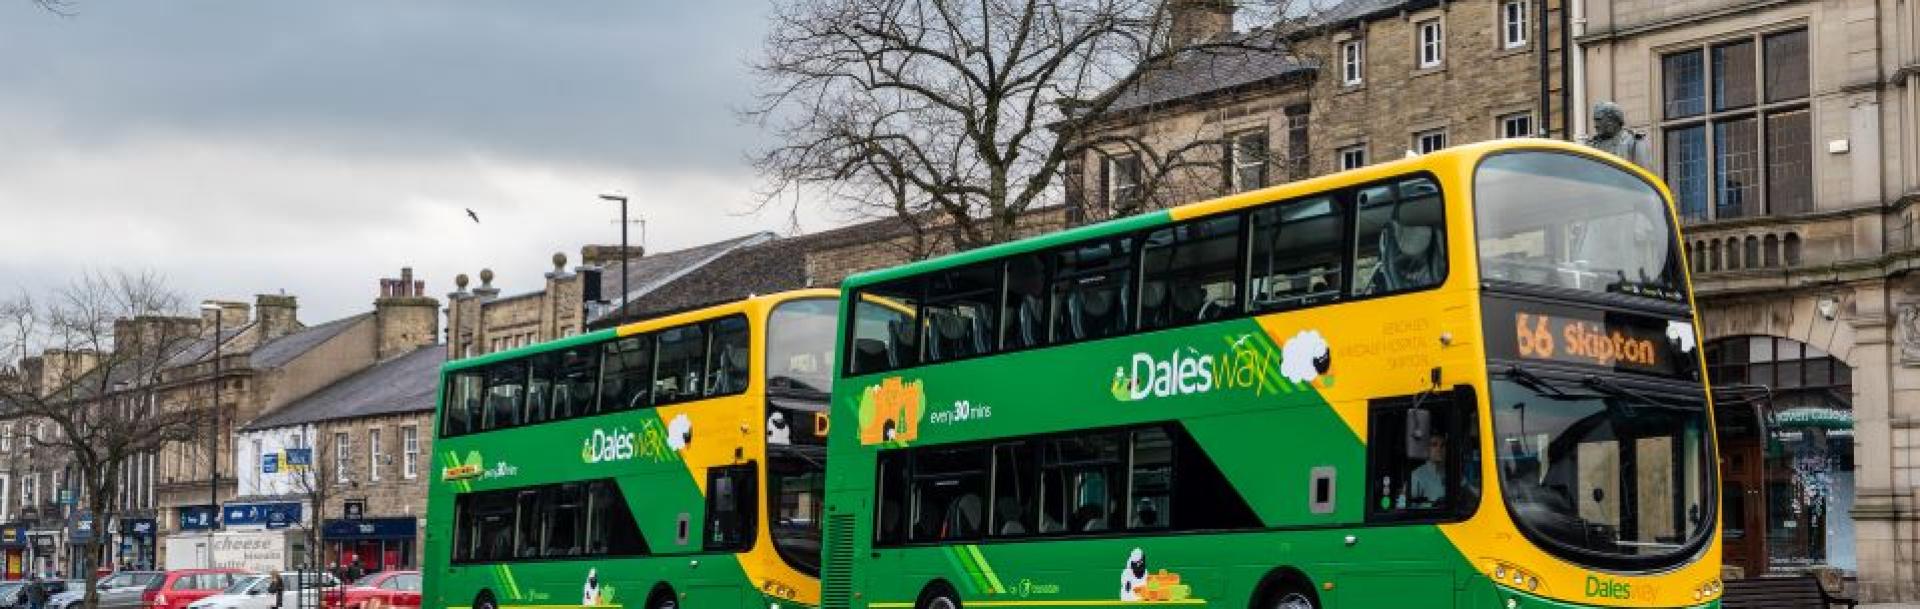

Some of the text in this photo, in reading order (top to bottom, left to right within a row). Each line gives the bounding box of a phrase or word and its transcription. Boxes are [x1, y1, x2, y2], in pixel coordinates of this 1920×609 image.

[1516, 312, 1655, 366] 66 Skipton
[954, 400, 970, 421] 30
[214, 536, 271, 551] cheese
